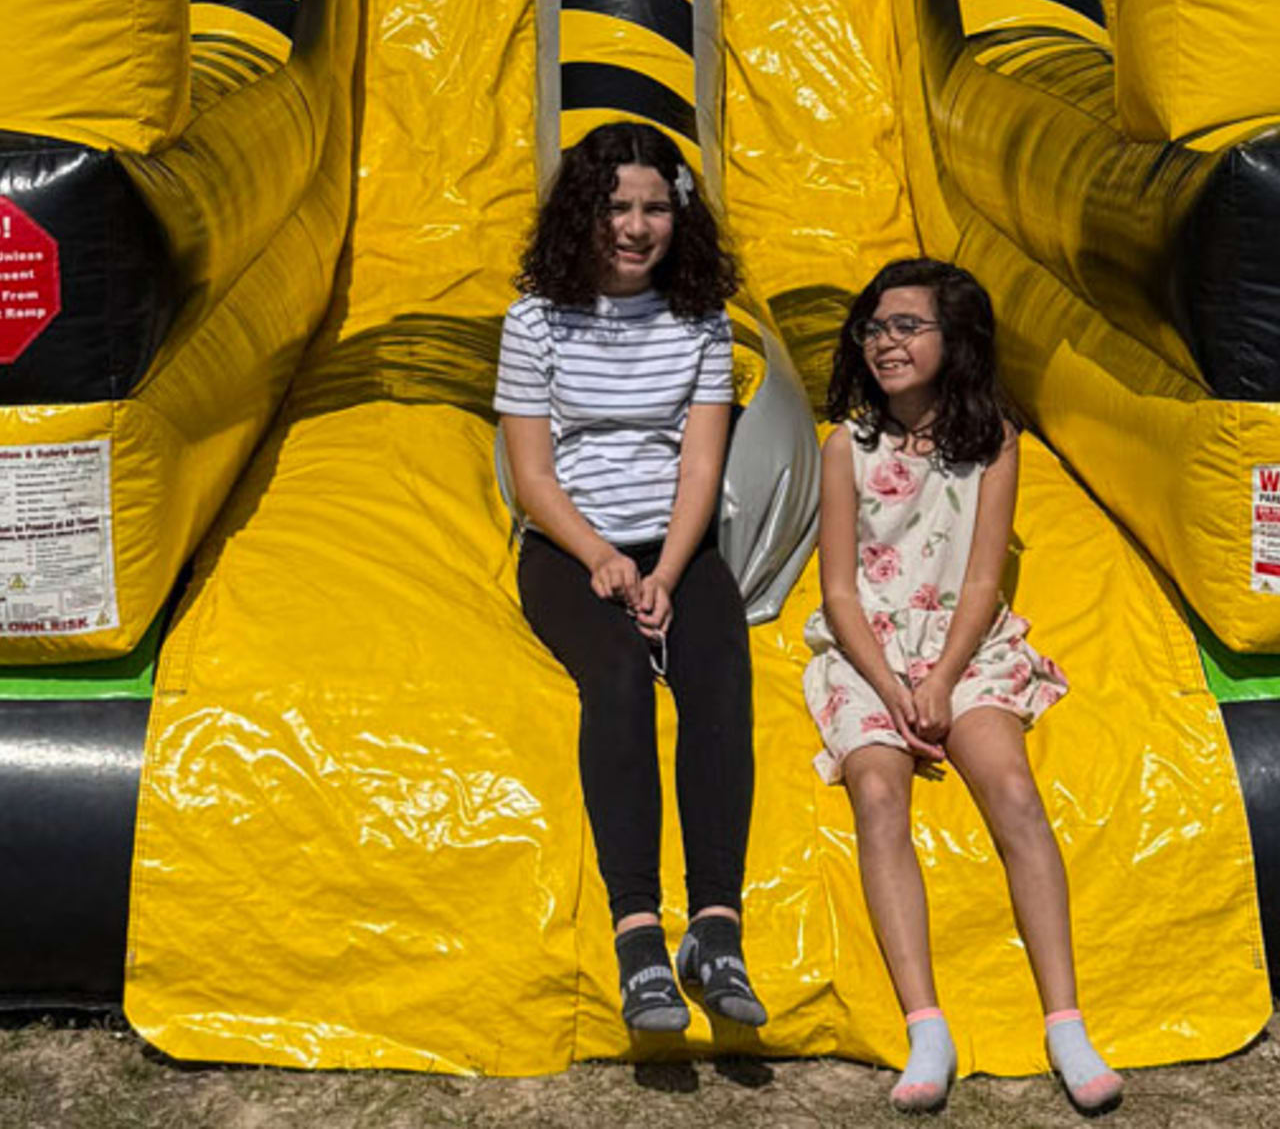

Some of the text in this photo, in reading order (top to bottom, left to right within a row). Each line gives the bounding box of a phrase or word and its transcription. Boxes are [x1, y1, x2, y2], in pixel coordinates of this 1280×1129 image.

[1, 290, 39, 302] From
[5, 308, 46, 320] Ramp
[8, 621, 45, 632] OWN
[51, 617, 89, 631] RISK
